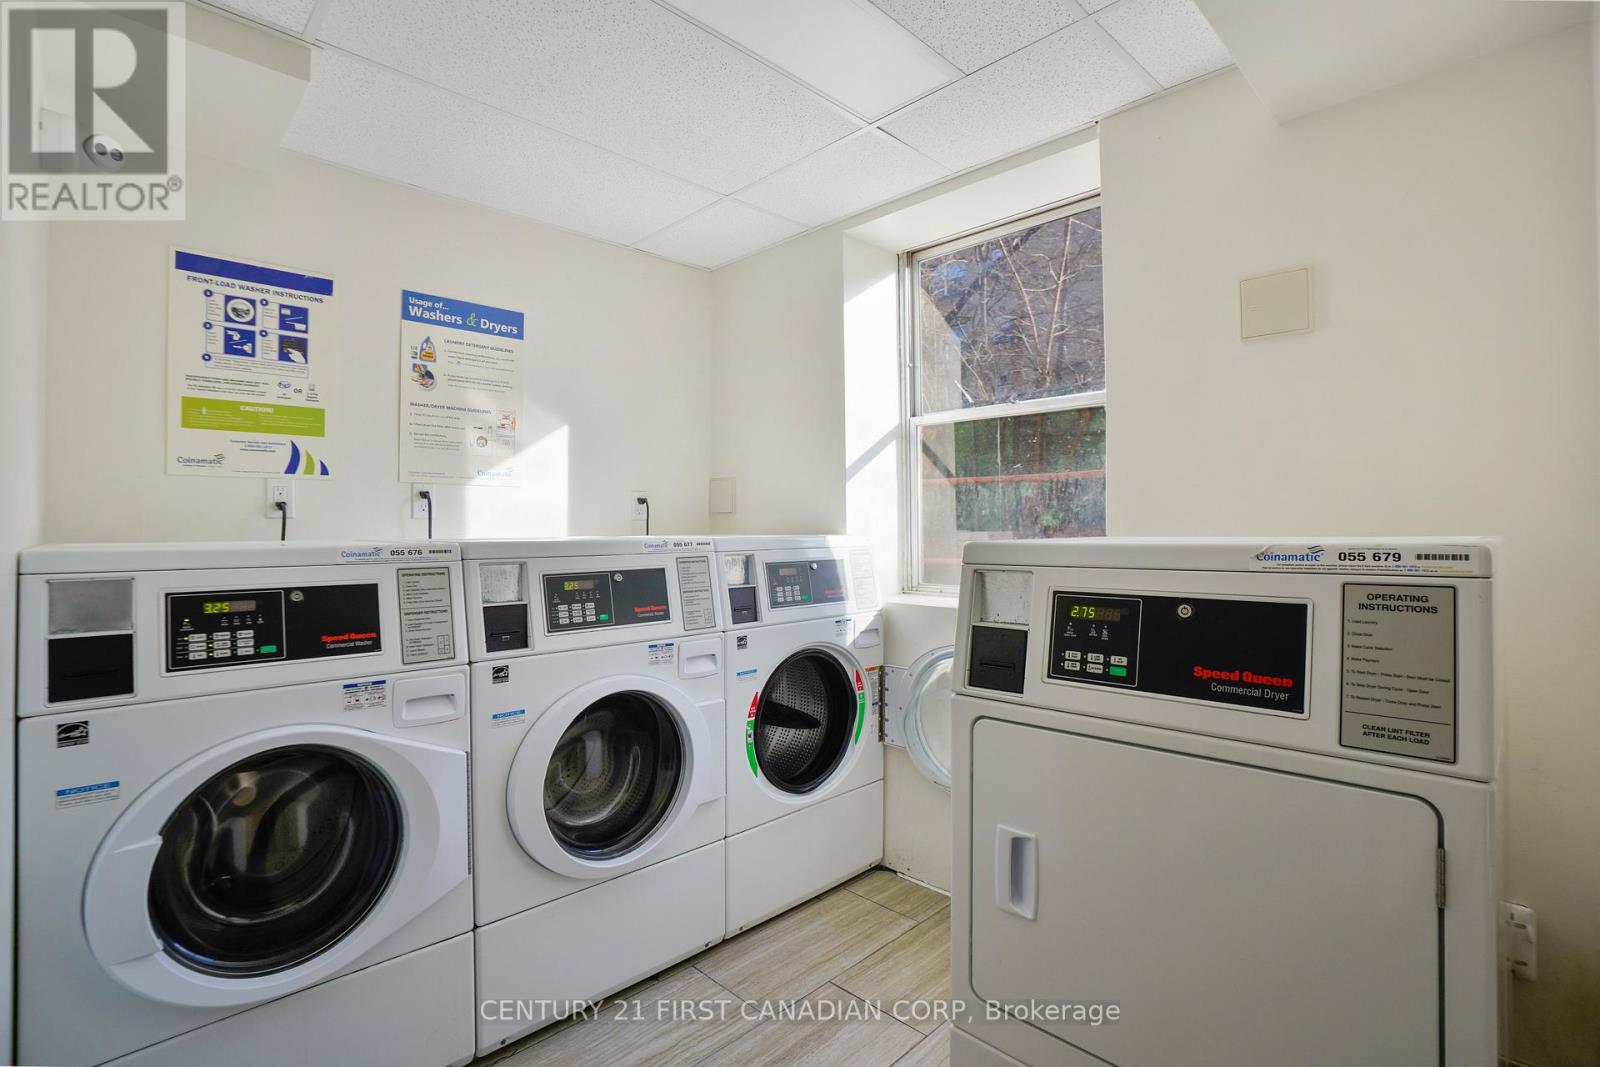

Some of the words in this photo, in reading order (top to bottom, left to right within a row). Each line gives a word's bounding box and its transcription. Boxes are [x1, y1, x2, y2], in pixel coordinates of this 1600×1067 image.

[187, 275, 237, 290] FRONT-LOAD
[238, 283, 271, 295] WASHER
[272, 290, 325, 304] INSTRUCTIONS
[408, 296, 433, 308] Usage
[408, 305, 463, 325] Washers
[466, 313, 478, 327] &
[480, 318, 518, 334] Dryers
[177, 456, 223, 465] Coinamatic
[341, 550, 381, 558] Coinamatic
[1338, 552, 1366, 562] 055
[1372, 552, 1402, 562] 679
[1367, 593, 1429, 603] OPERATING
[1071, 606, 1096, 618] 2.75
[1358, 603, 1439, 614] INSTRUCTIONS
[321, 633, 349, 643] Speed
[350, 632, 377, 641] Queen
[1193, 665, 1240, 682] Speed
[1241, 670, 1294, 688] Queen
[1211, 682, 1262, 698] Commercial
[1264, 689, 1290, 701] Dryer
[1362, 724, 1386, 732] CLEAN
[1387, 727, 1404, 735] LINT
[1405, 730, 1431, 739] FILTER
[1362, 731, 1386, 739] AFTER
[1387, 734, 1408, 742] EACH
[1408, 737, 1430, 745] LOAD
